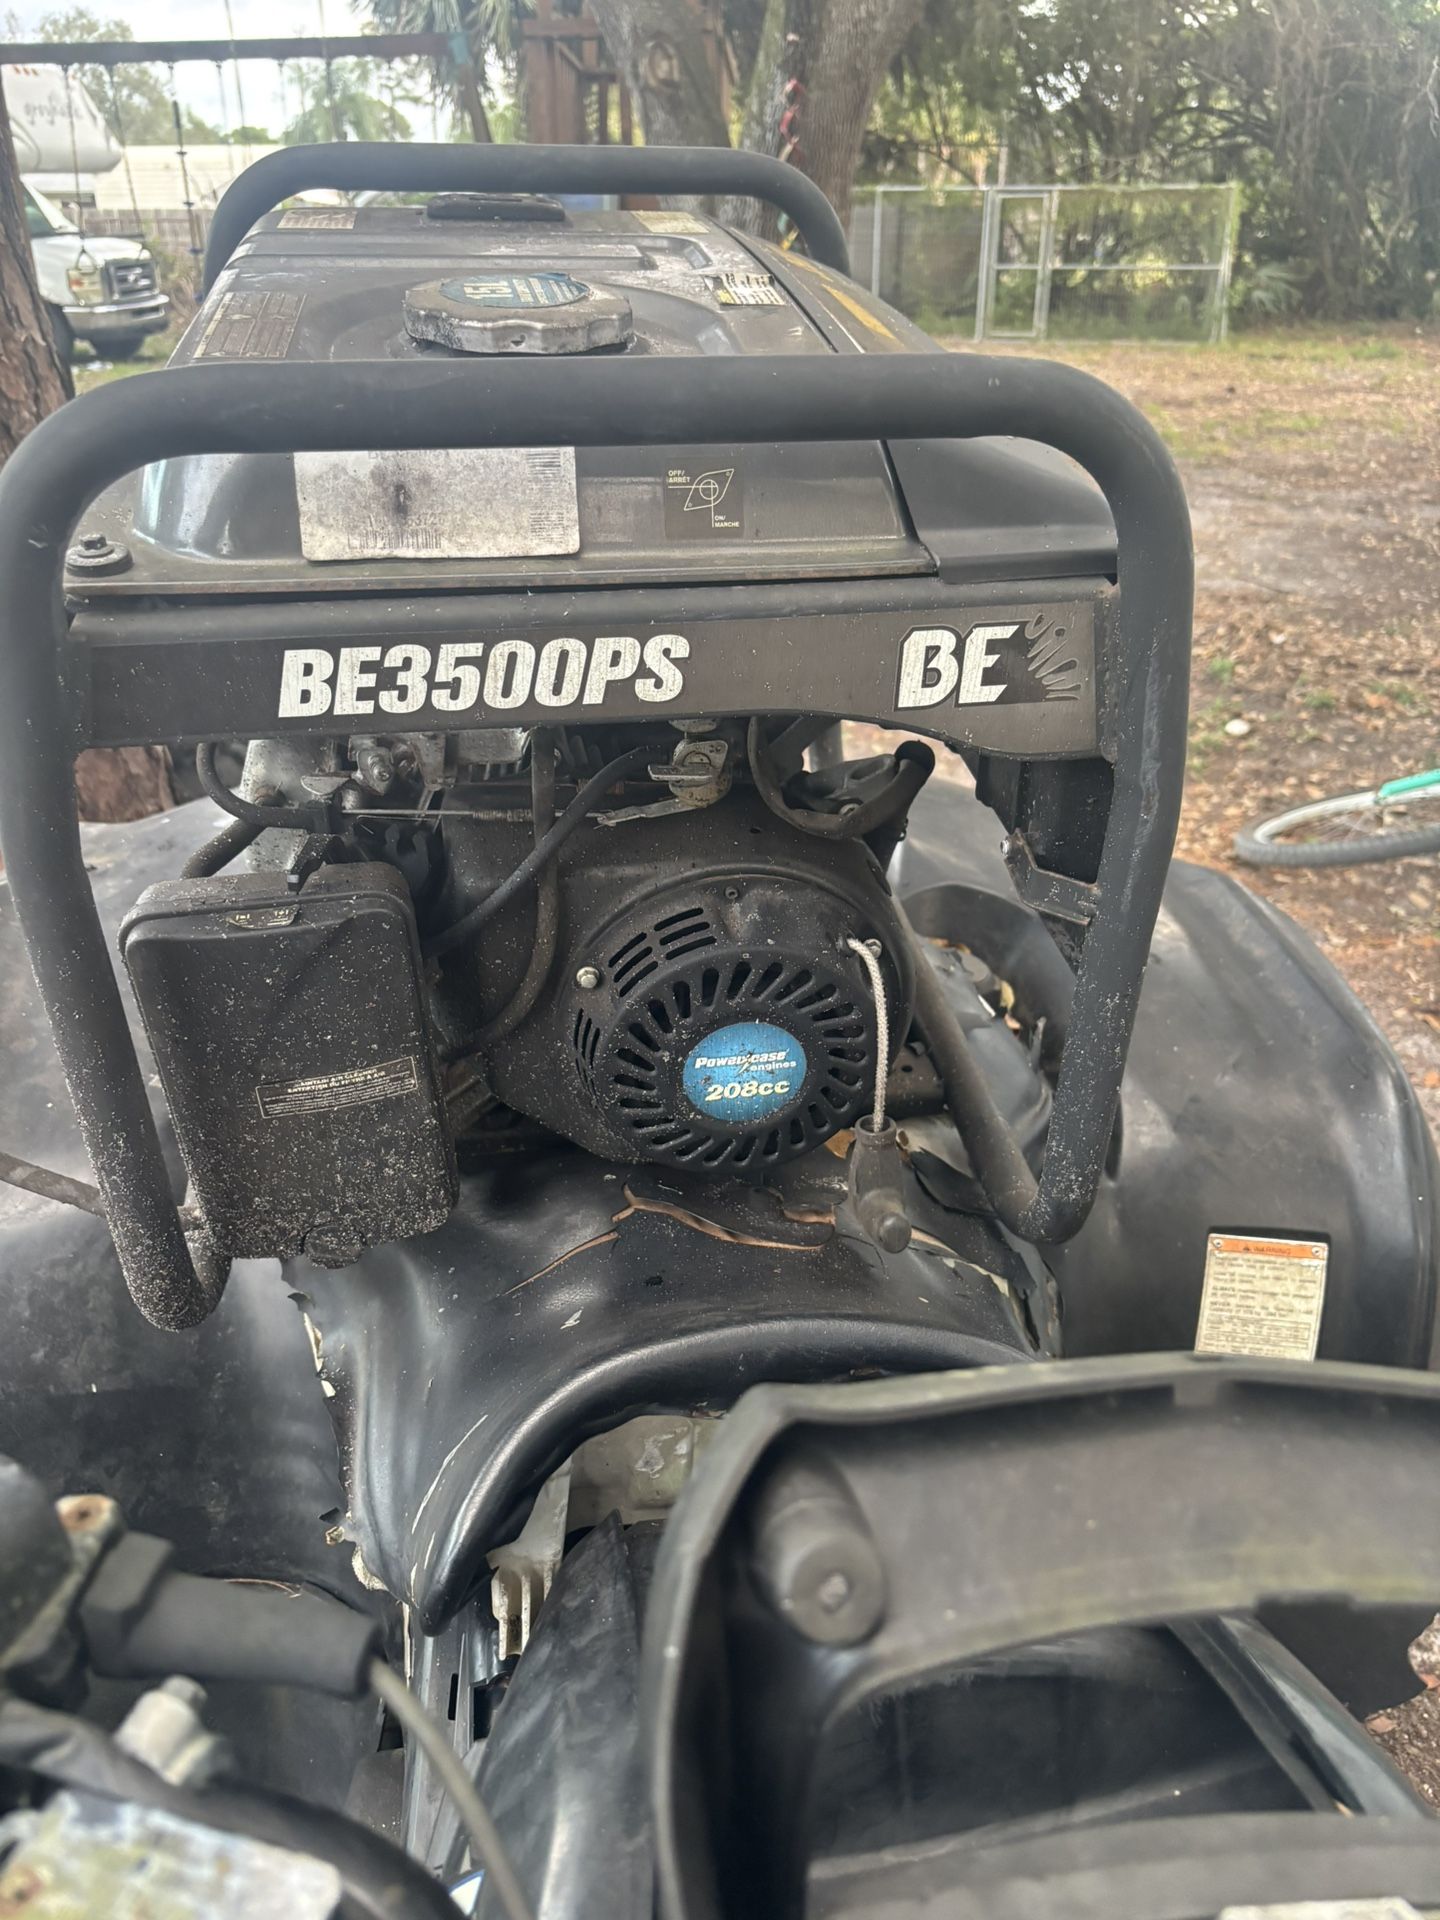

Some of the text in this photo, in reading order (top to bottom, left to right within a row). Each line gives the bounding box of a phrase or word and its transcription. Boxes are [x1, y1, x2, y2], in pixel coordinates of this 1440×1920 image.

[278, 634, 690, 718] BE3500PS
[897, 624, 1020, 708] BE
[705, 1081, 790, 1101] 208cc
[750, 1060, 797, 1071] engines
